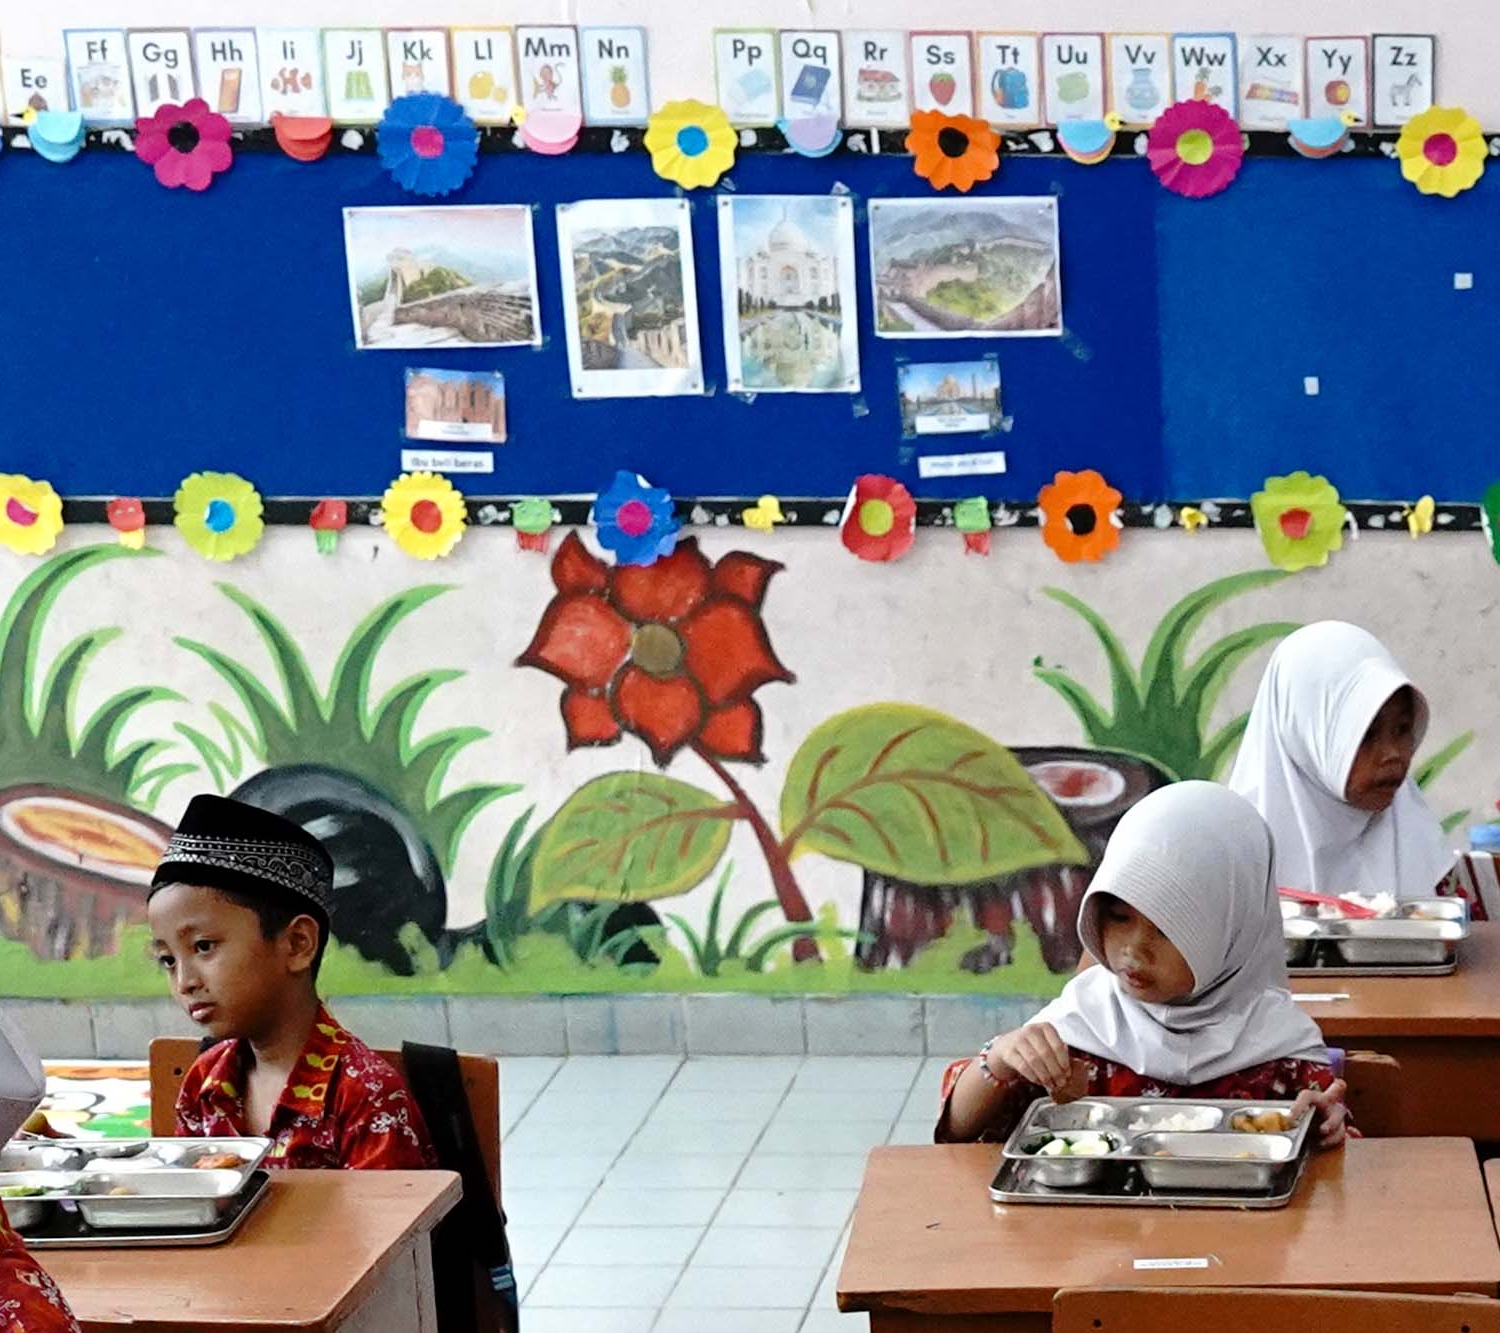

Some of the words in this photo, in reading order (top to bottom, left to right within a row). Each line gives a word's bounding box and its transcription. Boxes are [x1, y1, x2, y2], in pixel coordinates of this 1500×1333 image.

[87, 40, 107, 60] Ff
[143, 43, 178, 68] Gg
[212, 40, 242, 61] Hh
[347, 41, 362, 66] Jj
[404, 40, 432, 60] Kk
[525, 38, 569, 56] Mm
[599, 40, 628, 58] Nn
[733, 40, 761, 65] Pp
[793, 39, 826, 66] Qq
[865, 41, 887, 60] Rr
[927, 45, 954, 65] Ss
[996, 45, 1019, 64] Tt
[1058, 45, 1087, 64] Uu
[1125, 45, 1155, 64] Vv
[1391, 47, 1416, 65] Zz
[1182, 48, 1225, 67] Ww
[1258, 48, 1285, 66] Xx
[1323, 50, 1351, 75] Yy
[21, 69, 46, 88] Ee
